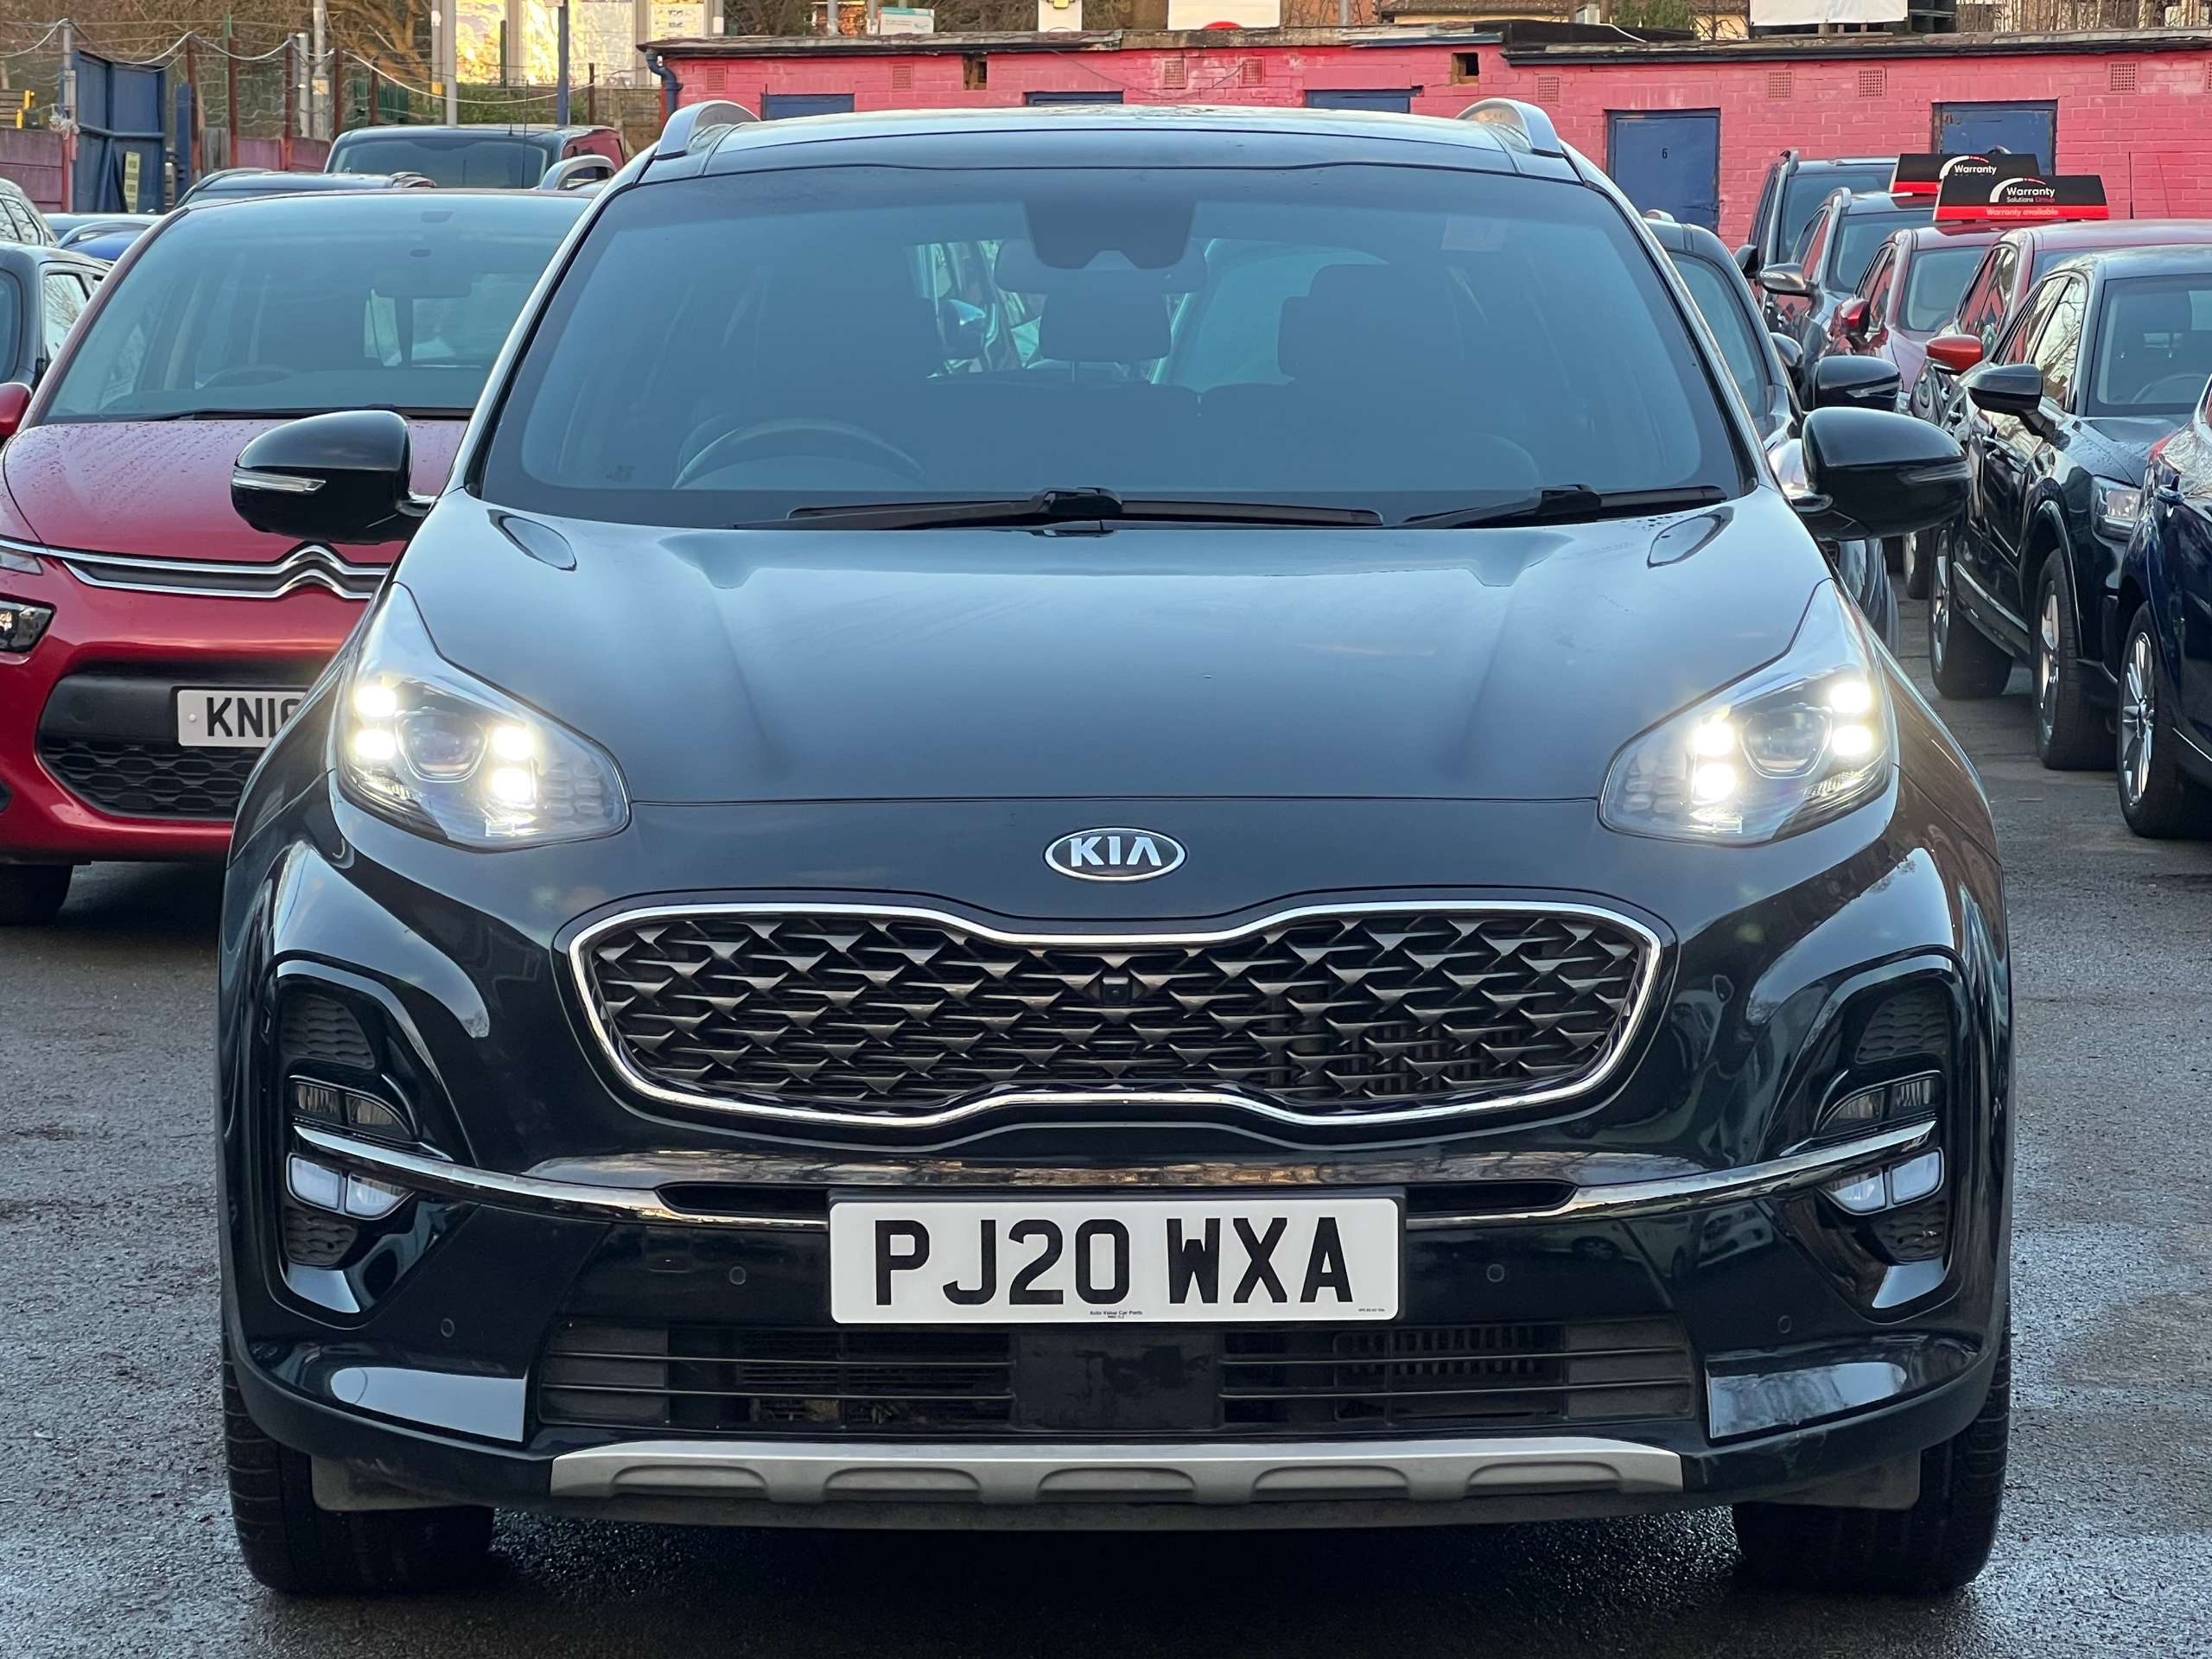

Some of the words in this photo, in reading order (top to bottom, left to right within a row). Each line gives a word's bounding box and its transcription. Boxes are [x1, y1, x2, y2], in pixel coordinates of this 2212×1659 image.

[1662, 148, 1669, 159] 6
[1954, 164, 1998, 175] Warranty
[2006, 187, 2056, 198] Warranty
[1986, 207, 2022, 217] Warranty
[2023, 207, 2059, 216] available
[1069, 836, 1162, 868] KIA
[875, 1218, 1130, 1306] PJ20
[1166, 1217, 1353, 1306] WXA
